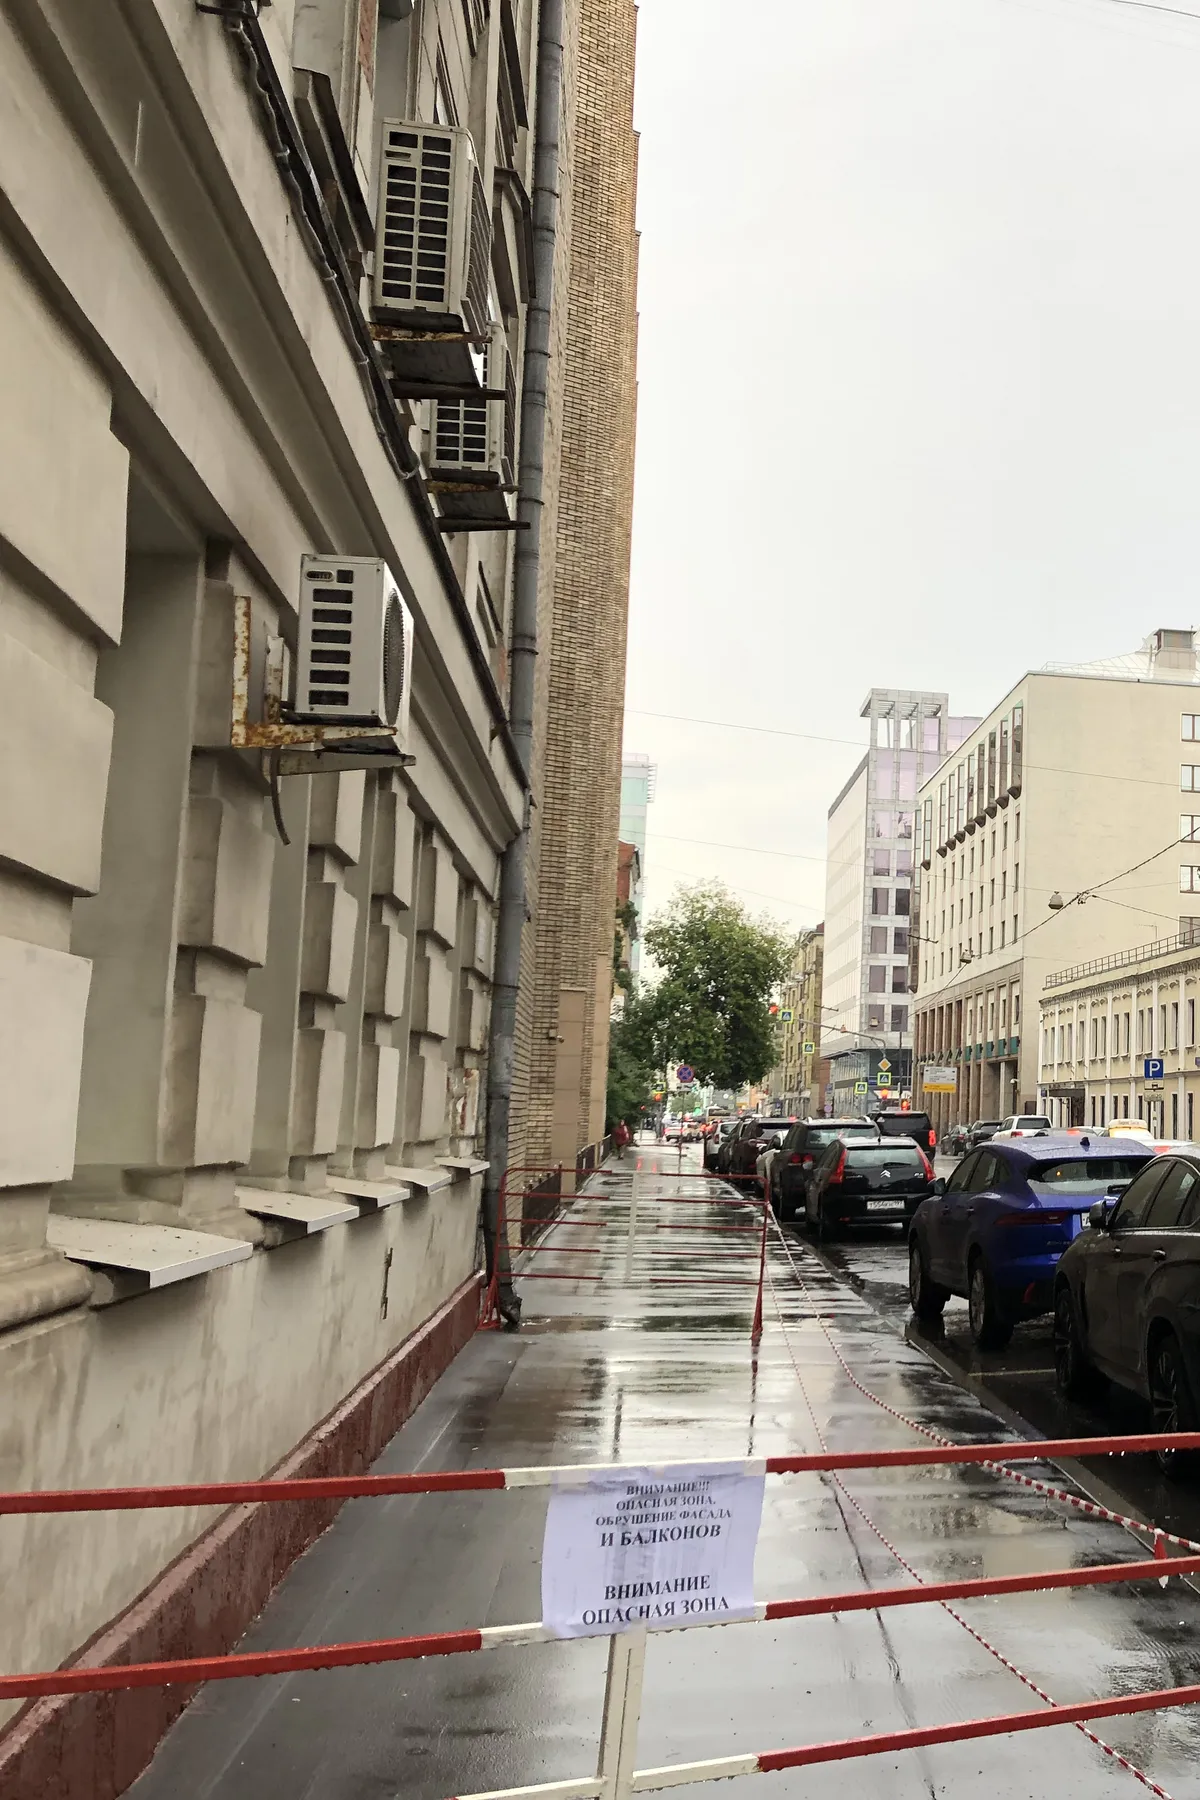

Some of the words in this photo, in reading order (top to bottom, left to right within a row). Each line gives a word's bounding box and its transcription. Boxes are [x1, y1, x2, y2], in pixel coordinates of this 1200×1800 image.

[1149, 1060, 1160, 1077] P
[626, 1481, 710, 1496] ВНИМАНИЕ!!!
[616, 1497, 678, 1511] ОПАСНАЯ
[680, 1495, 716, 1506] ЗОНА.
[595, 1510, 677, 1526] ОБРУШЕНИЕ
[679, 1508, 732, 1520] ФАСАДА
[600, 1532, 615, 1547] И
[620, 1524, 722, 1547] БАЛКОНОВ
[604, 1575, 711, 1600] ВНИМАНИЕ
[582, 1601, 676, 1626] ОПАСНАЯ
[680, 1596, 729, 1615] ЗОНА
